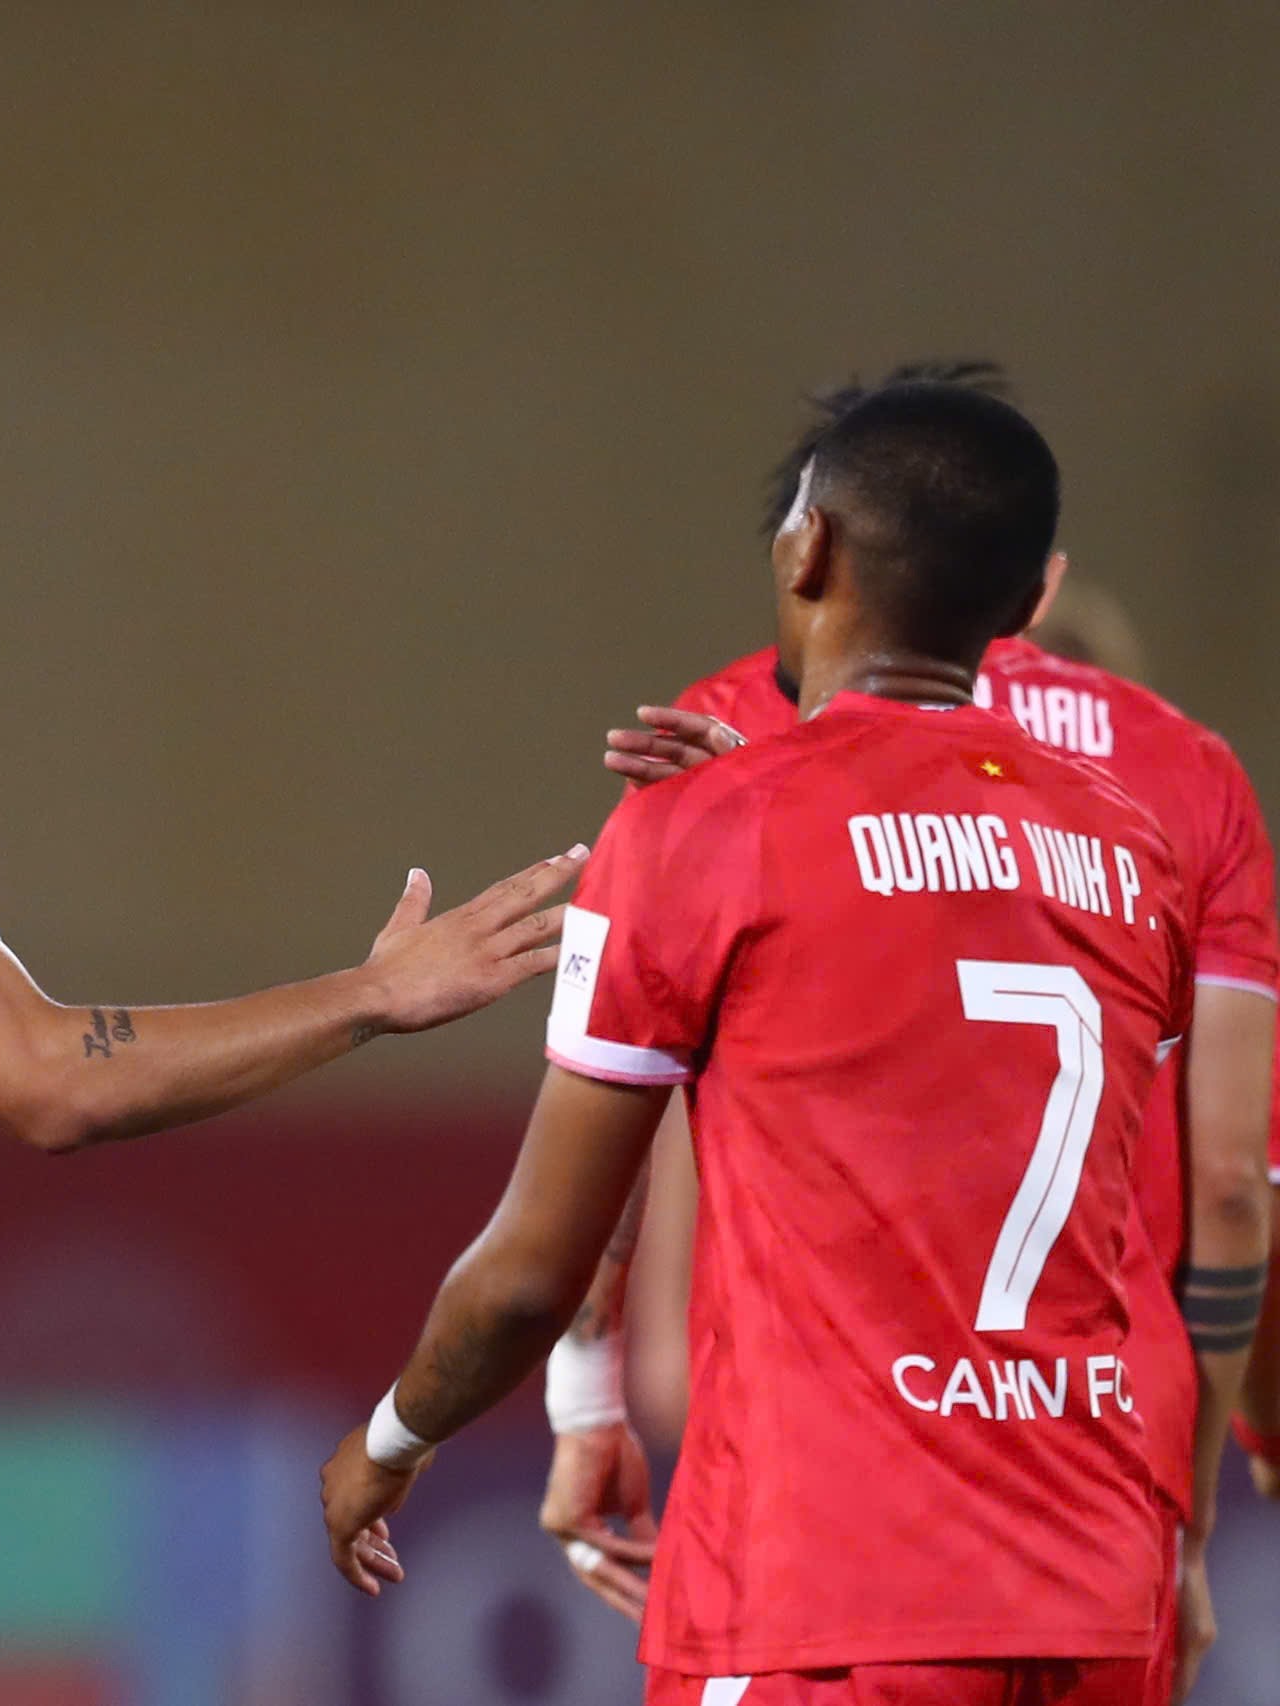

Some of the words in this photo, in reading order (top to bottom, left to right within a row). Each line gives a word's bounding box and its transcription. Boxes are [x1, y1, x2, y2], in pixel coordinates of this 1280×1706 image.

[1009, 682, 1114, 758] HAU
[848, 813, 1020, 896] QUANG
[1021, 820, 1112, 917] VINH
[956, 960, 1104, 1331] 7
[892, 1355, 1067, 1420] CAHN
